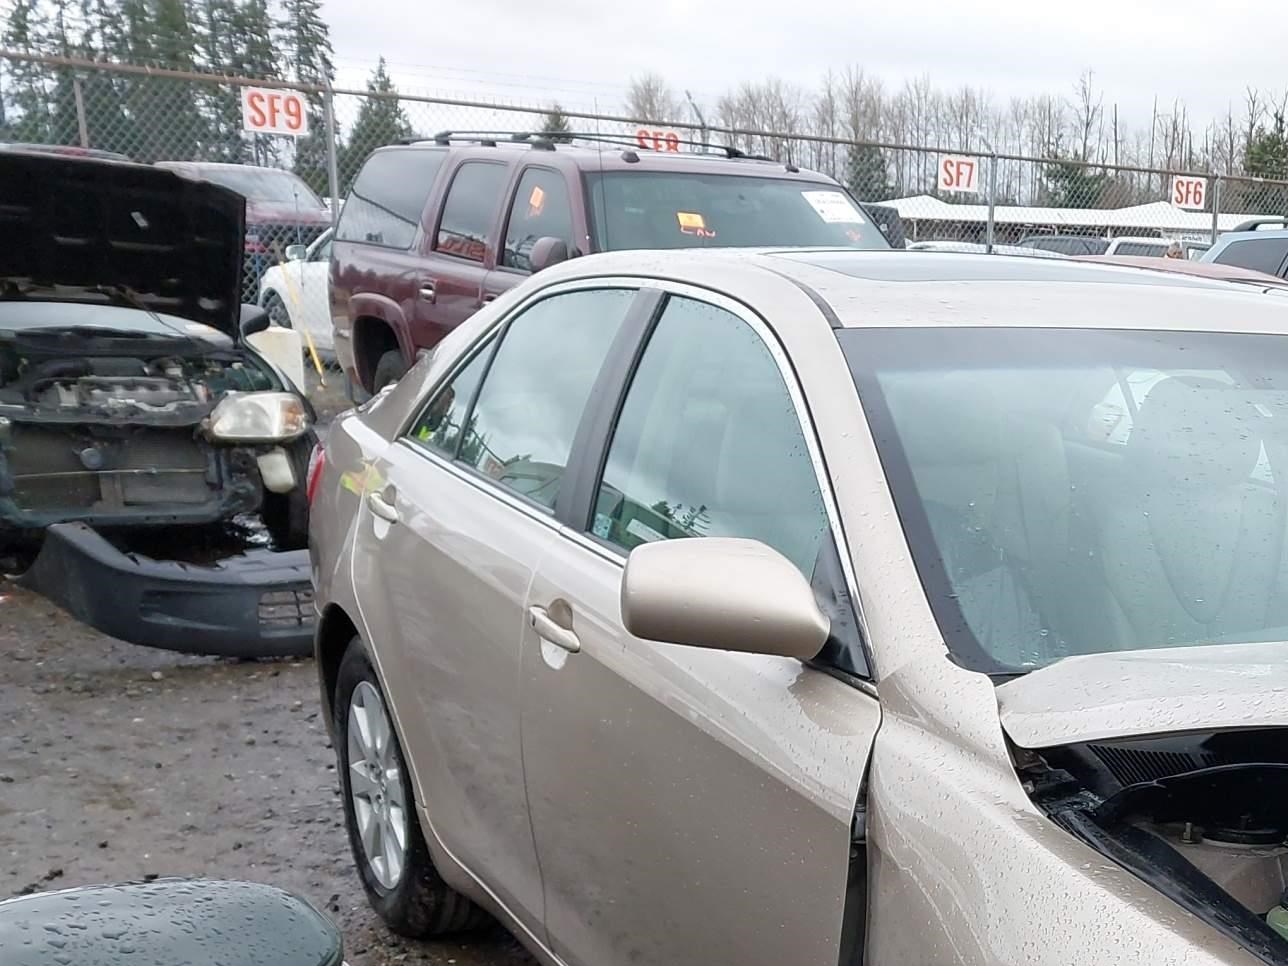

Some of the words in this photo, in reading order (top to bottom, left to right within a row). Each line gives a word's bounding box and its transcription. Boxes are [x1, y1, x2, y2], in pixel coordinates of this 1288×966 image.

[247, 92, 302, 130] SF9
[943, 159, 974, 188] SF7
[1175, 180, 1203, 205] SF6
